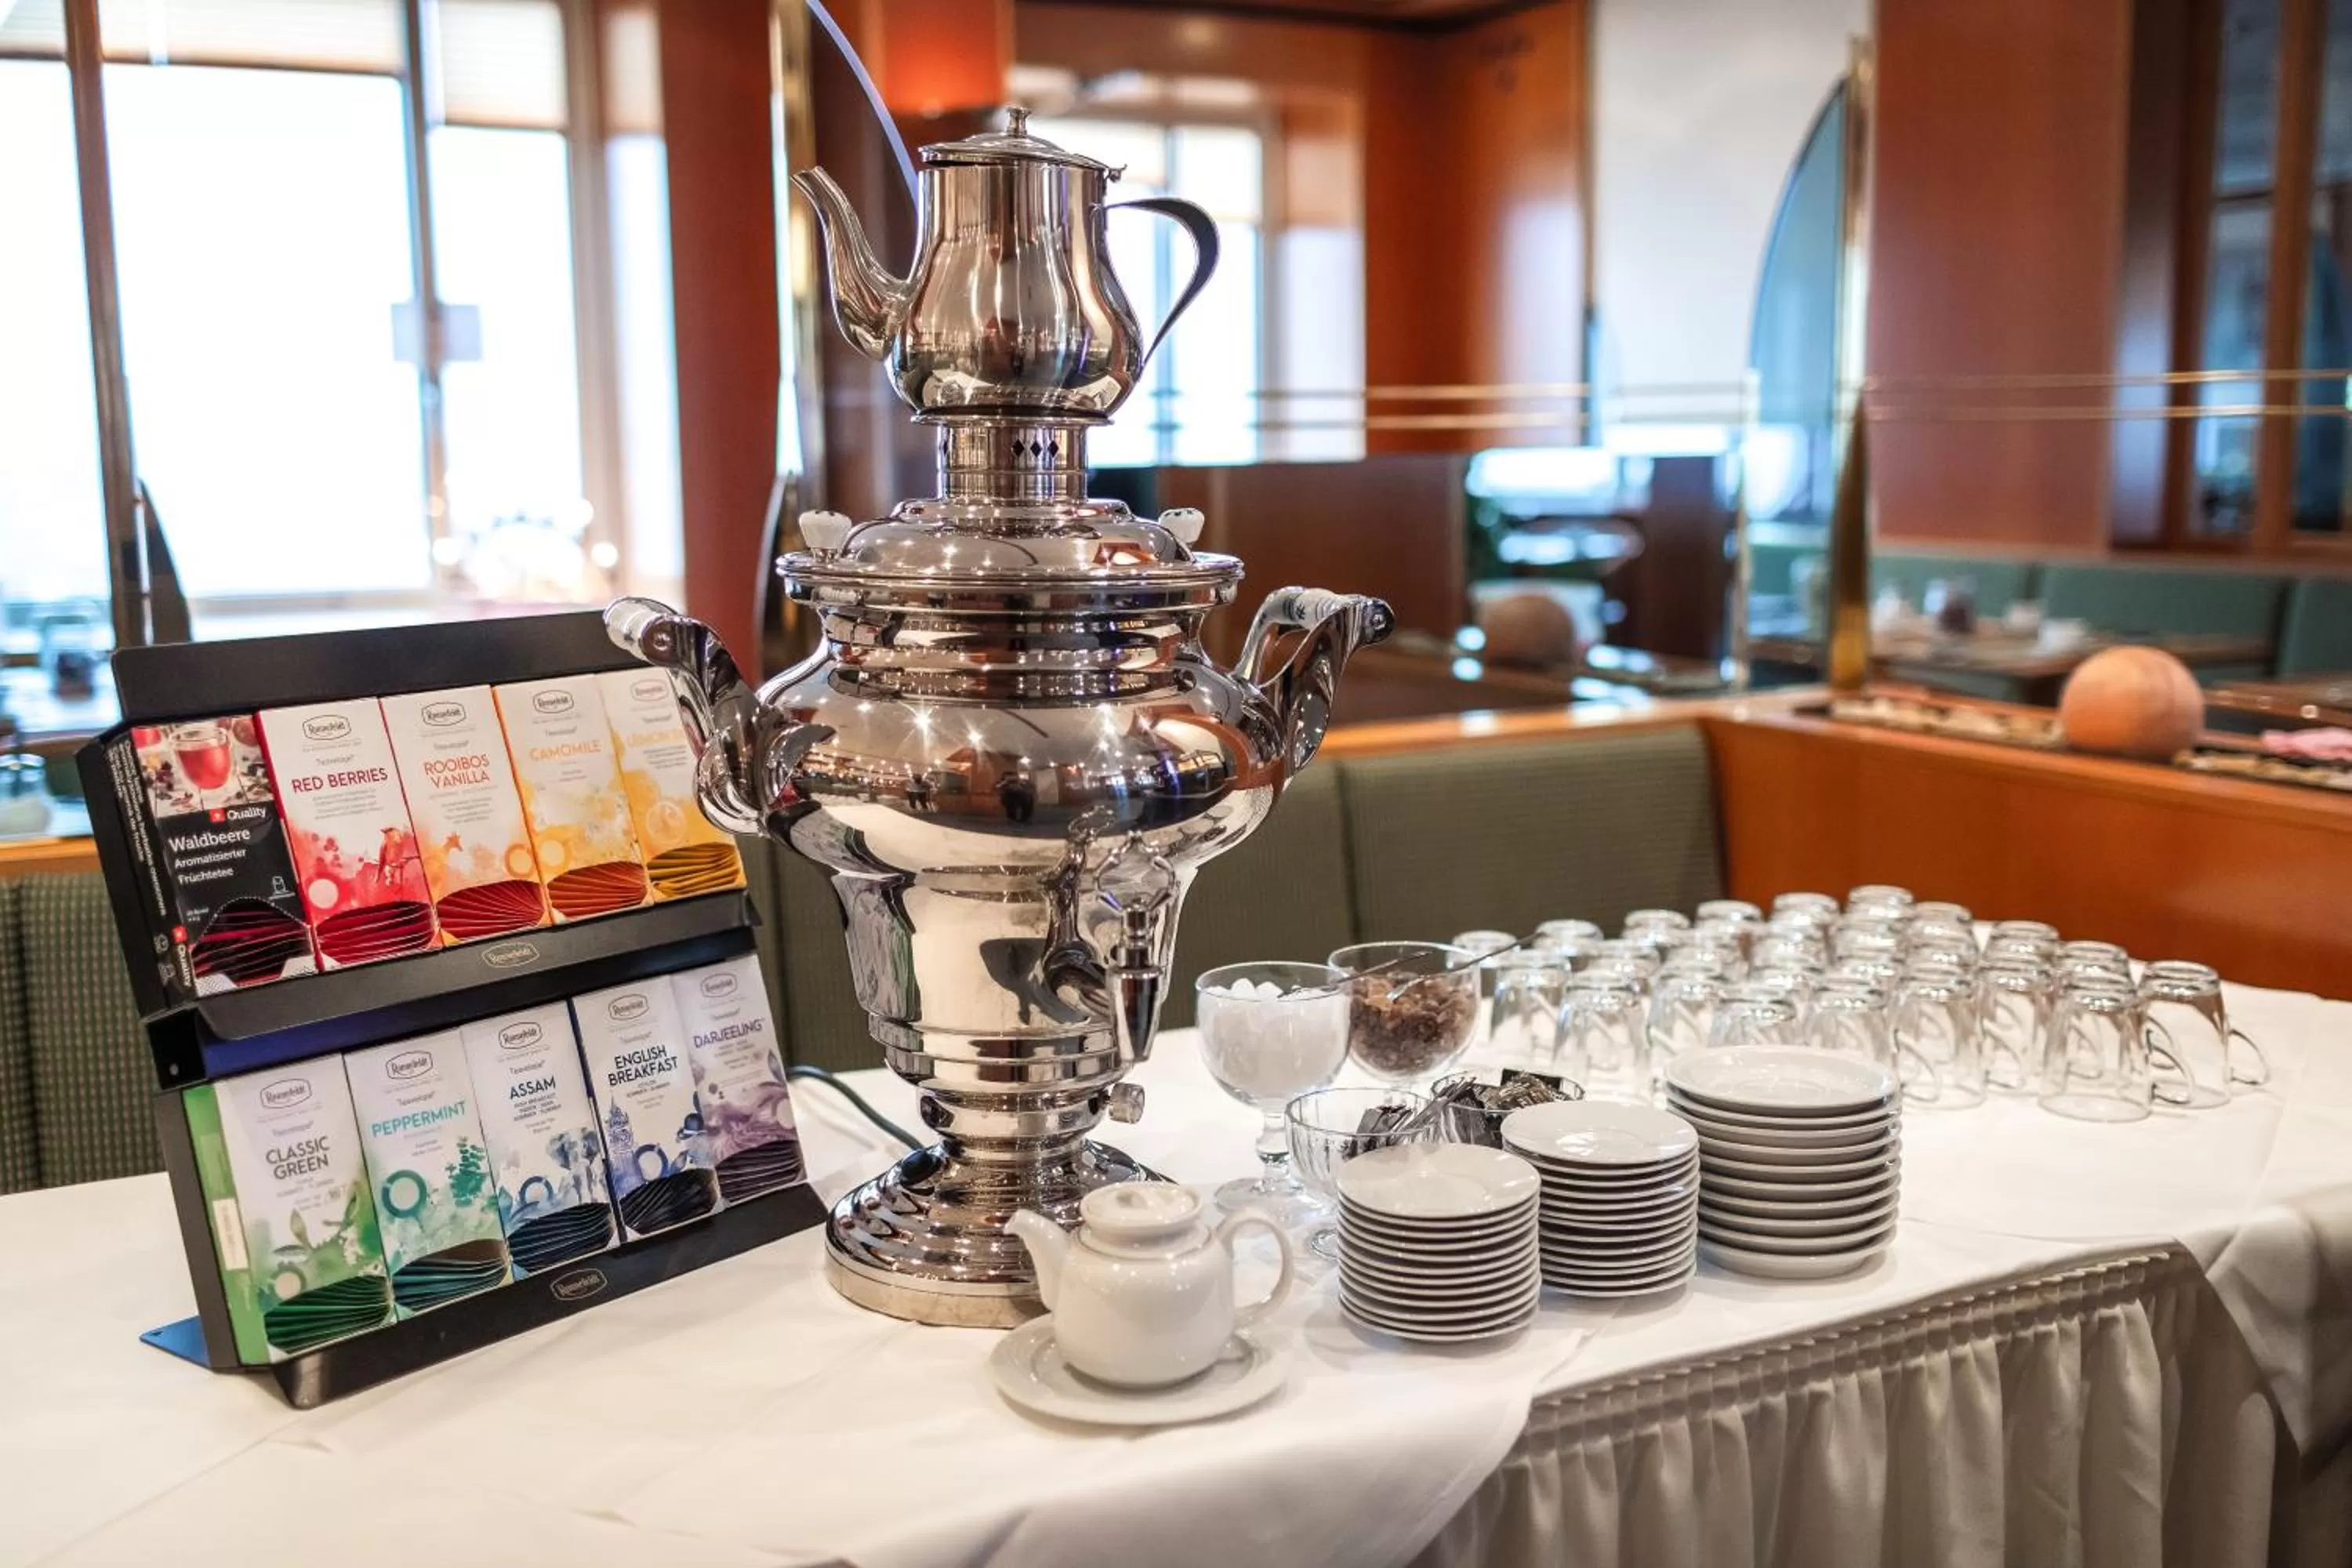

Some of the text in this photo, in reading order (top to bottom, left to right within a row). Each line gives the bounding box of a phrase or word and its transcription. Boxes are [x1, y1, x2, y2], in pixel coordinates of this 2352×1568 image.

[424, 754, 489, 775] ROOIBOS
[292, 768, 388, 793] RED BERRIES
[430, 771, 489, 788] VANILLA
[227, 807, 266, 822] Quality
[169, 829, 251, 852] Waldbeere
[174, 848, 247, 869] Aromatisierter
[614, 1044, 666, 1069] ENGLISH
[608, 1056, 677, 1087] BREAKFAST
[510, 1075, 556, 1100] ASSAM
[372, 1101, 465, 1138] PEPPERMINT
[265, 1135, 330, 1165] CLASSIC
[273, 1154, 328, 1180] GREEN
